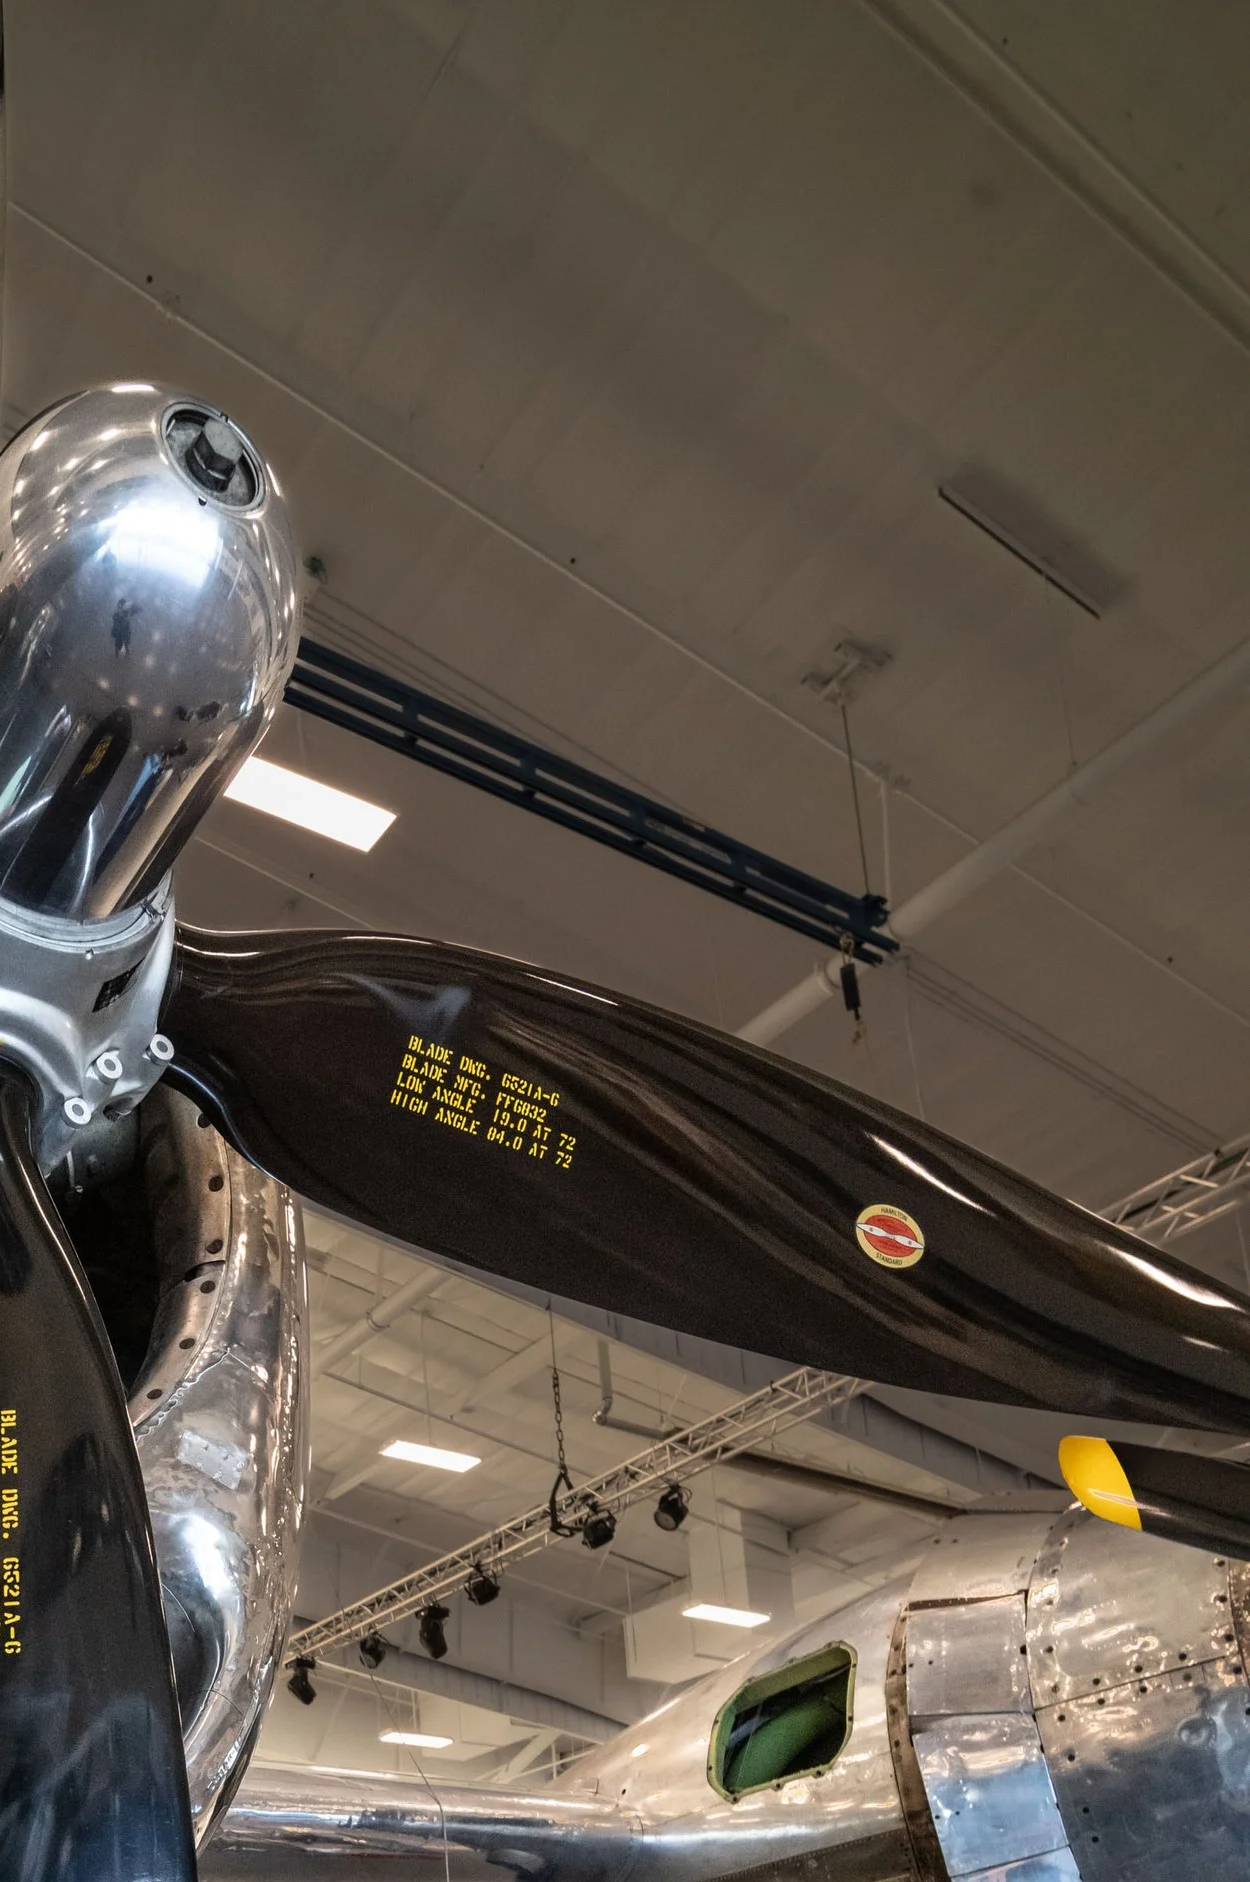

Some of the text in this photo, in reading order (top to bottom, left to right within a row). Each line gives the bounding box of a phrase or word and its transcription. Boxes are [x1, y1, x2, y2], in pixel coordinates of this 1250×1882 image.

[402, 1054, 448, 1083] BLADE
[454, 1075, 485, 1100] MFG.
[408, 1035, 454, 1065] BLADE
[459, 1056, 491, 1081] DWG.
[390, 1090, 573, 1169] HIGH ANGLE 84.0 AT 72
[397, 1073, 576, 1151] LOW ANGLE 19.0 AT 72
[880, 1207, 908, 1222] HAMILTON
[875, 1253, 903, 1265] STANDARD
[0, 1410, 21, 1654] BLADE DWG. 6521A-6
